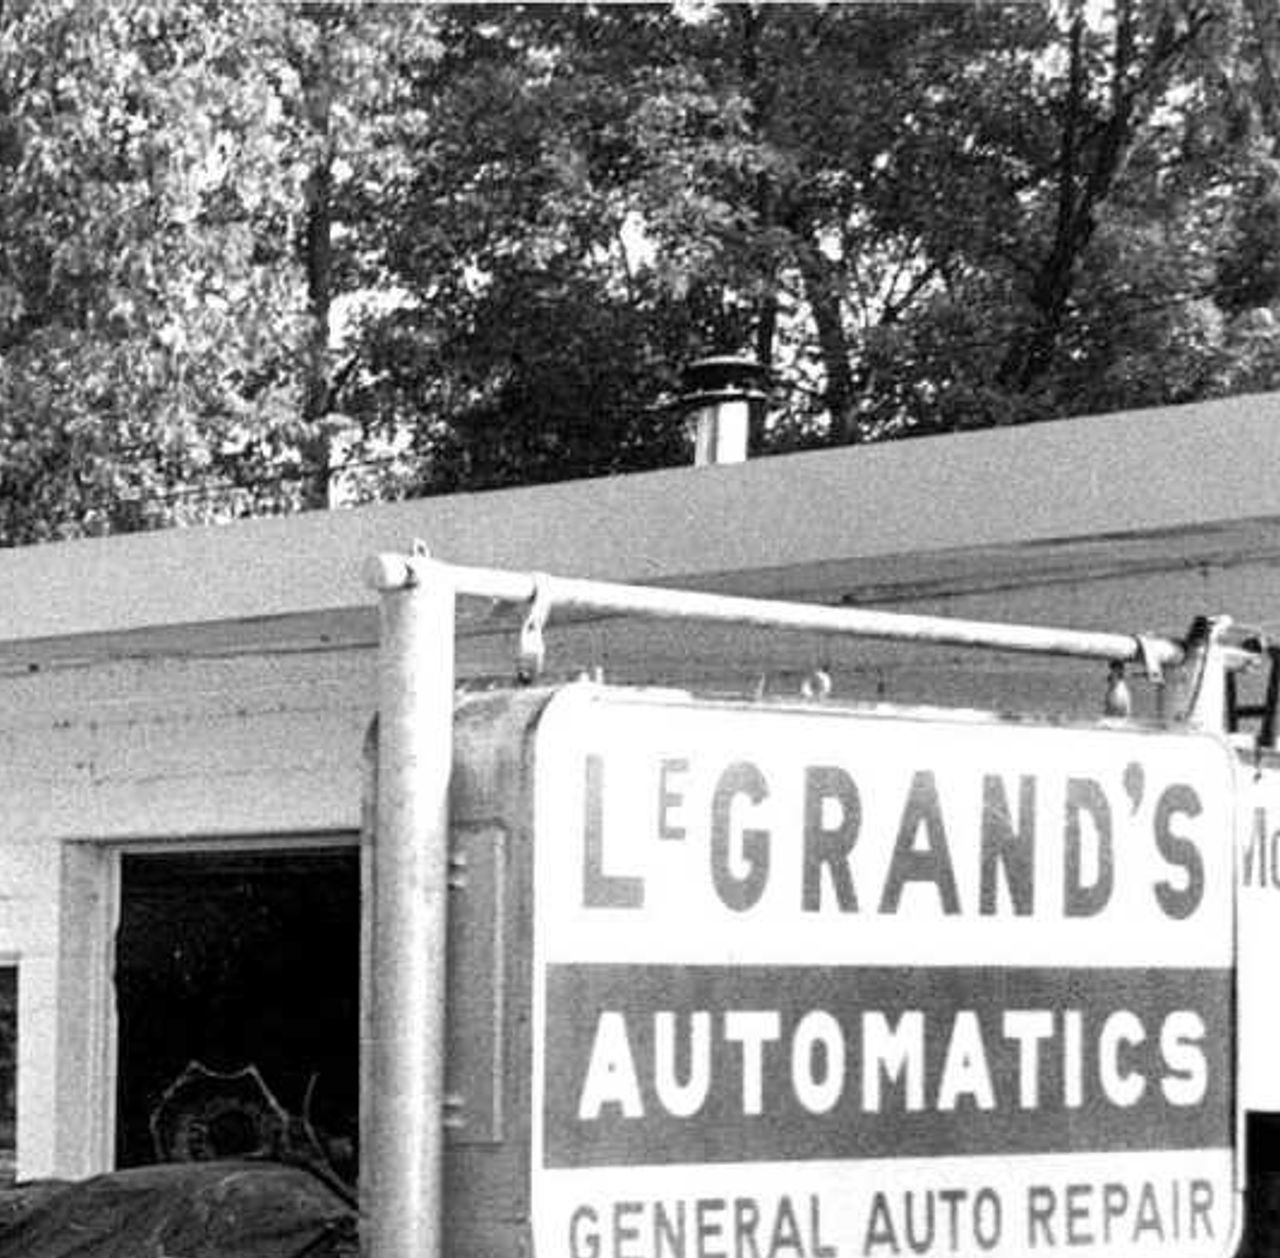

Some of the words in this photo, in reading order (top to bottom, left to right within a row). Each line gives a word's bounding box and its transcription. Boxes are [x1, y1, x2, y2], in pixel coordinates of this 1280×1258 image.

[578, 1010, 1208, 1121] AUTOMATICS
[861, 1187, 1003, 1258] AUTO
[1026, 1178, 1215, 1249] REPAIR
